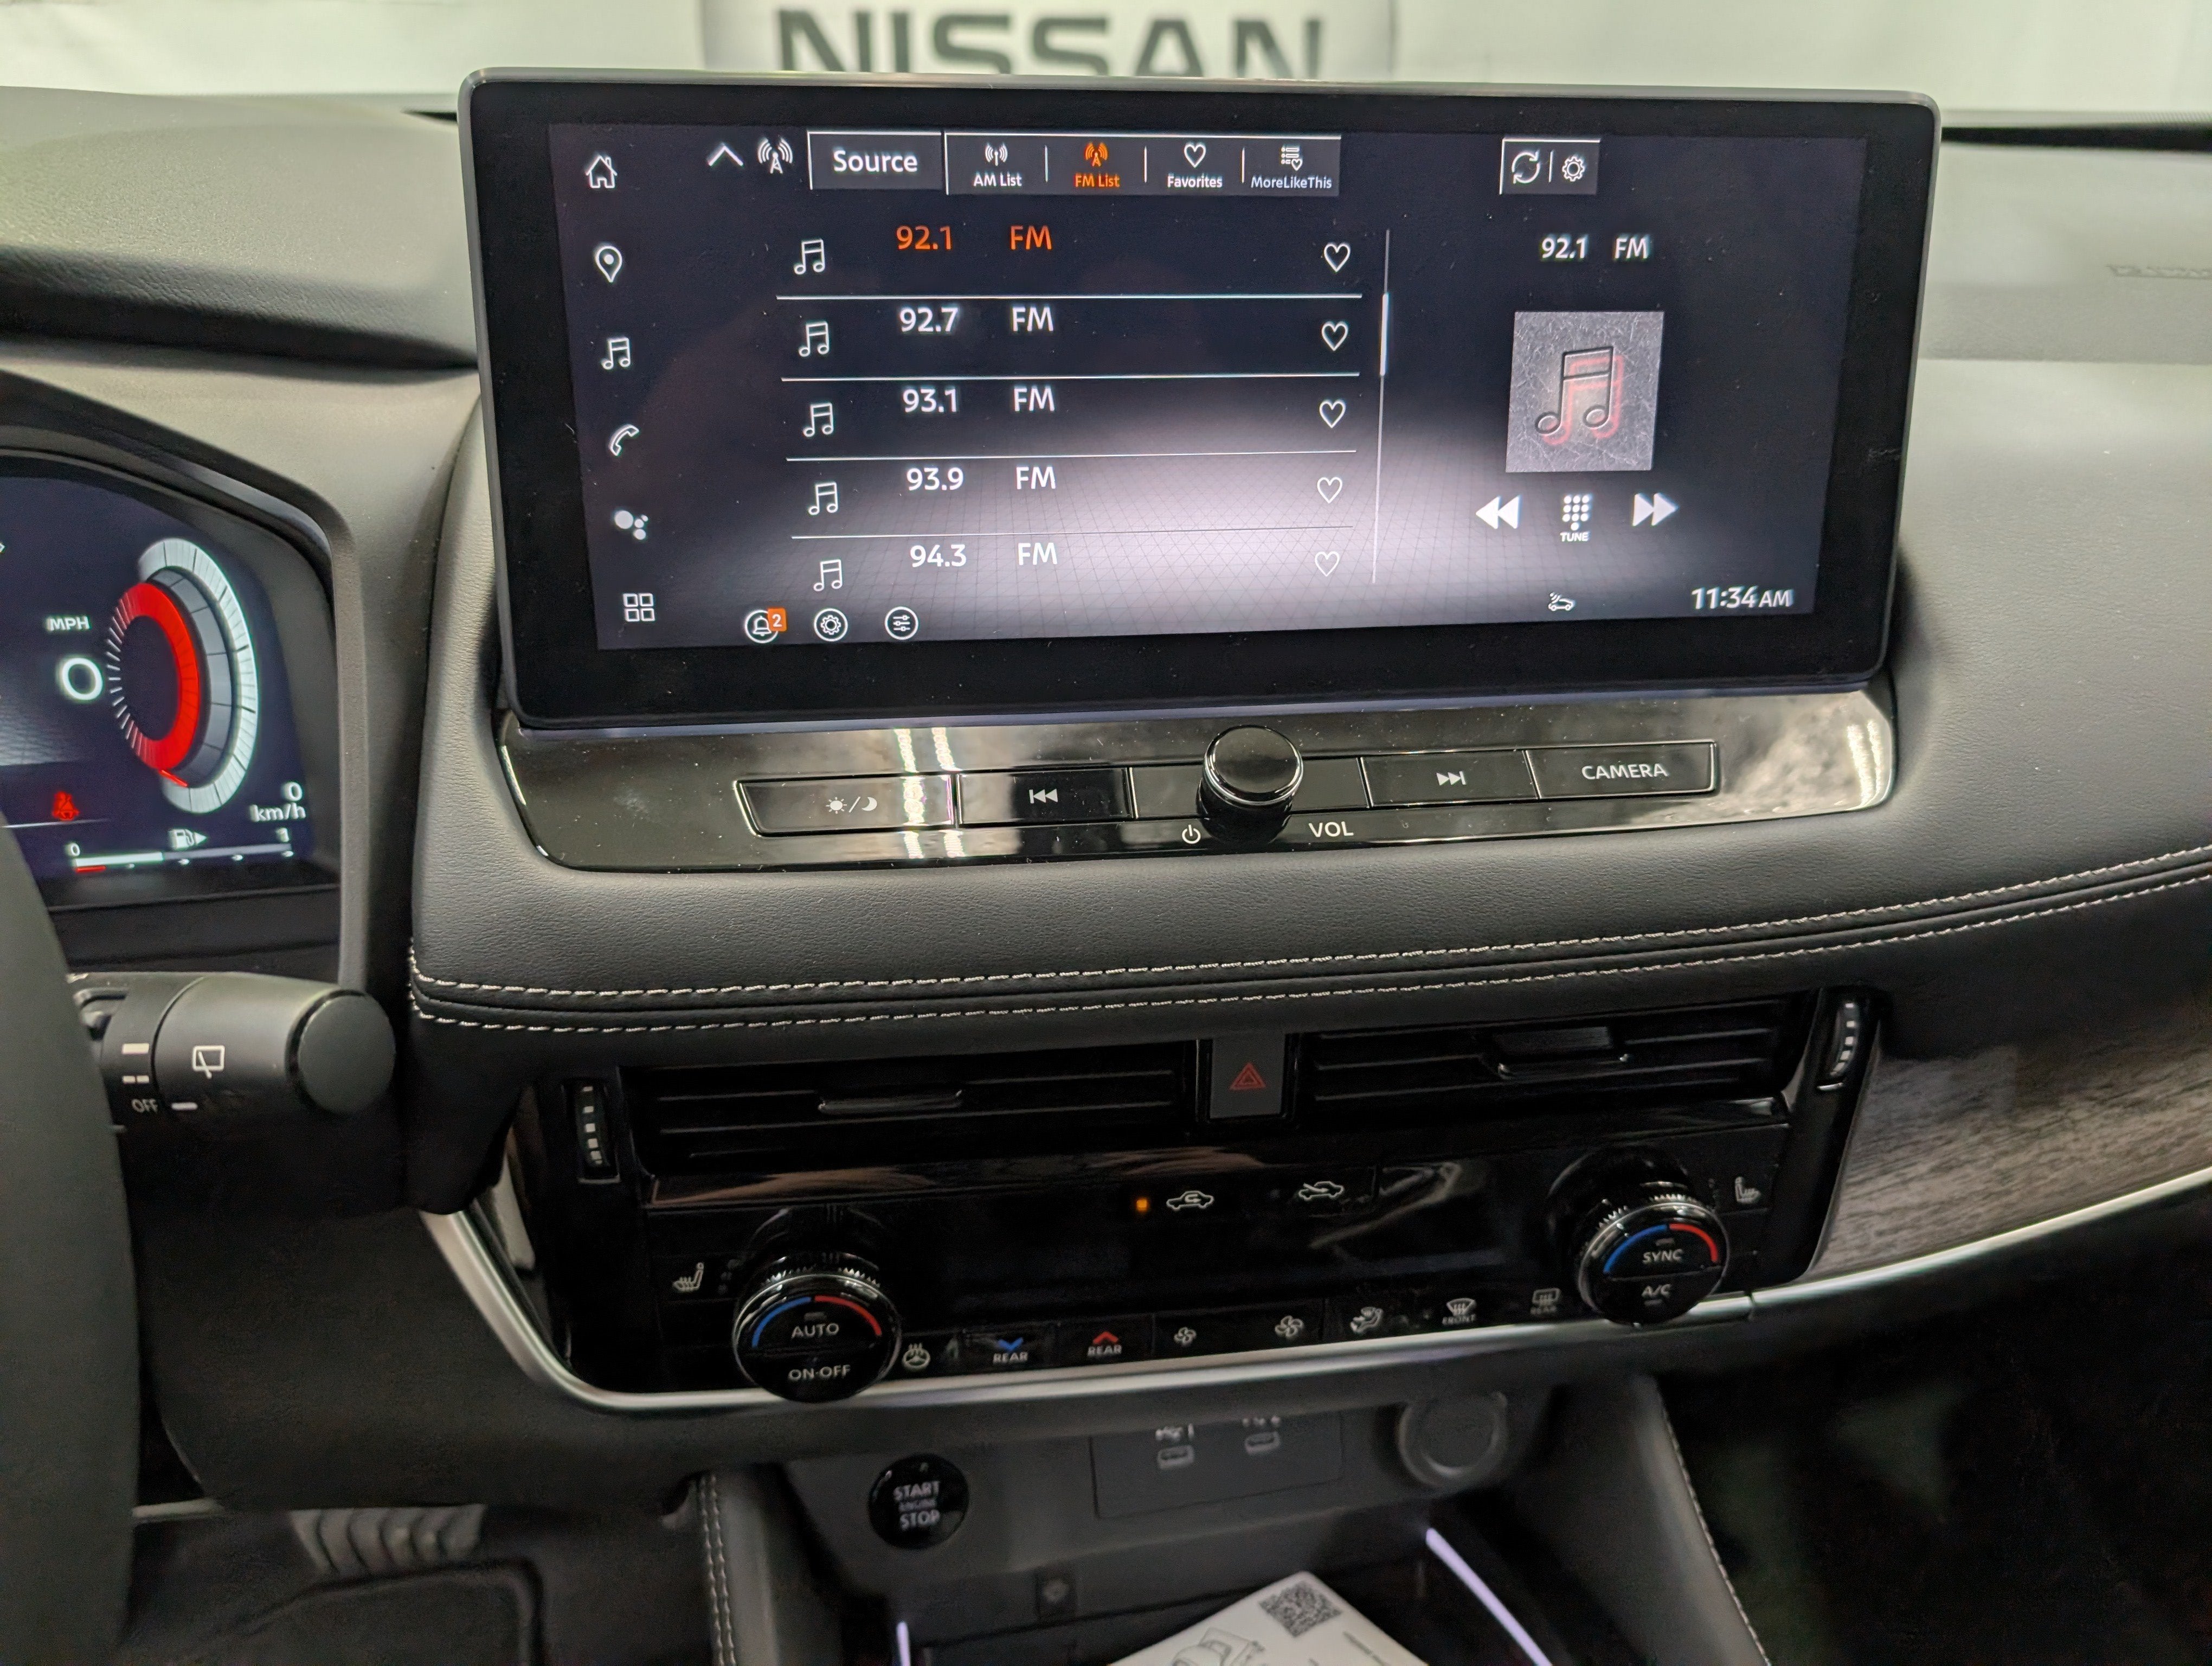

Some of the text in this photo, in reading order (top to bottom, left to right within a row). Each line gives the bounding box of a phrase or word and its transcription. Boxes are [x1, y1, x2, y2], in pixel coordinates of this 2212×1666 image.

[777, 10, 1322, 79] NISSAN
[833, 149, 918, 172] Source
[973, 174, 1022, 187] AM List
[1075, 174, 1120, 188] FM List
[1167, 174, 1223, 188] Favorites
[1251, 175, 1332, 189] MoreLikeThis
[896, 226, 1052, 250] 92.1 FM
[1541, 236, 1650, 259] 92.1 FM
[899, 307, 1054, 332] 92.7 FM
[902, 386, 1055, 412] 93.1 FM
[906, 466, 1056, 491] 93.9 FM
[1560, 531, 1589, 542] TUNE
[910, 542, 1058, 567] 94.3 FM
[48, 616, 89, 631] MPH
[773, 614, 782, 627] 2
[59, 657, 103, 700] 0
[1581, 763, 1668, 780] CAMERA
[283, 781, 303, 802] 0
[249, 803, 306, 823] km/h
[1309, 821, 1354, 837] VOL
[67, 844, 81, 857] 0
[132, 1099, 158, 1113] OFF
[1642, 1248, 1683, 1265] SYNC
[1642, 1284, 1671, 1298] A/C
[791, 1323, 839, 1338] AUTO
[993, 1352, 1028, 1364] REAR
[1088, 1344, 1122, 1356] REAR
[893, 1481, 940, 1502] START
[900, 1509, 940, 1530] STOP
